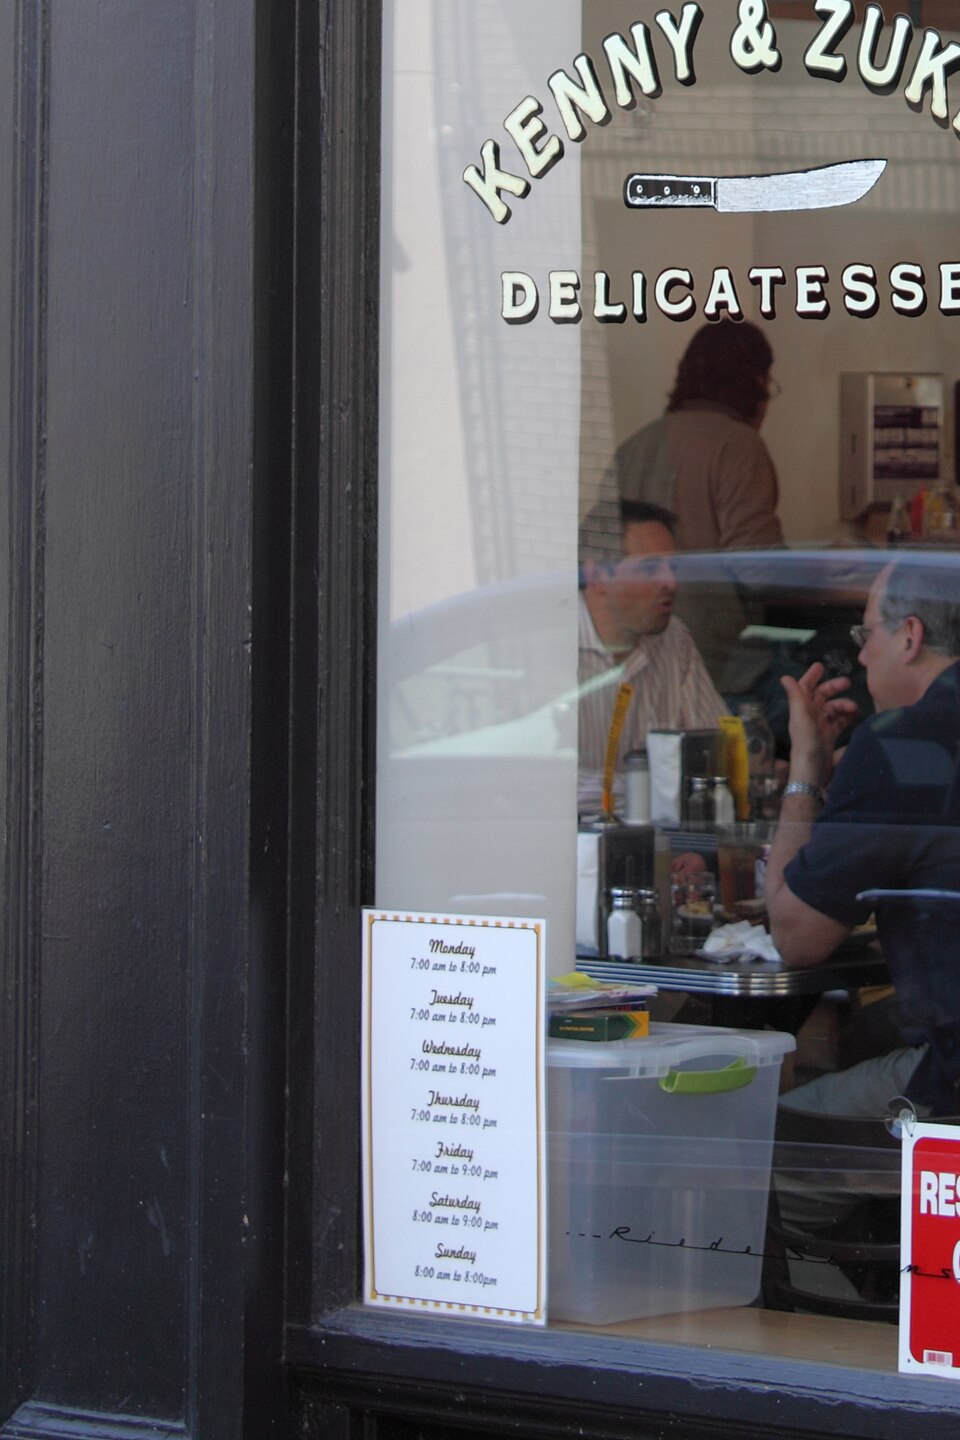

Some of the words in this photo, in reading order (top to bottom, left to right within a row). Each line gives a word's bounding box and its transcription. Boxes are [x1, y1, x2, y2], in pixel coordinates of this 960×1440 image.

[463, 1, 702, 224] KENNY
[429, 939, 476, 959] Monday
[410, 958, 431, 971] 7:00
[432, 962, 446, 972] am
[460, 961, 480, 974] 8:00
[482, 964, 497, 977] pm
[428, 990, 474, 1010] Tuesday
[410, 1008, 430, 1022] 7:00
[432, 1012, 446, 1022] am
[460, 1011, 480, 1025] 8:00
[481, 1014, 496, 1027] pm
[422, 1040, 482, 1061] Wednesday
[410, 1058, 430, 1072] 7:00
[432, 1063, 446, 1073] am
[460, 1062, 480, 1075] 8:00
[481, 1065, 496, 1078] pm
[426, 1090, 480, 1112] Thursday
[411, 1109, 431, 1122] 7:00
[433, 1113, 447, 1123] am
[461, 1112, 481, 1126] 8:00
[482, 1115, 498, 1128] pm
[435, 1141, 474, 1161] Friday
[411, 1159, 432, 1173] 7:00
[434, 1164, 448, 1174] am
[461, 1163, 482, 1176] 9:00
[483, 1166, 498, 1179] pm
[429, 1192, 482, 1213] Saturday
[412, 1210, 432, 1224] 8:00
[434, 1214, 448, 1224] am
[462, 1213, 482, 1227] 9:00
[483, 1216, 499, 1229] pm
[434, 1242, 477, 1263] Sunday
[414, 1265, 434, 1279] 8:00
[436, 1269, 451, 1280] am
